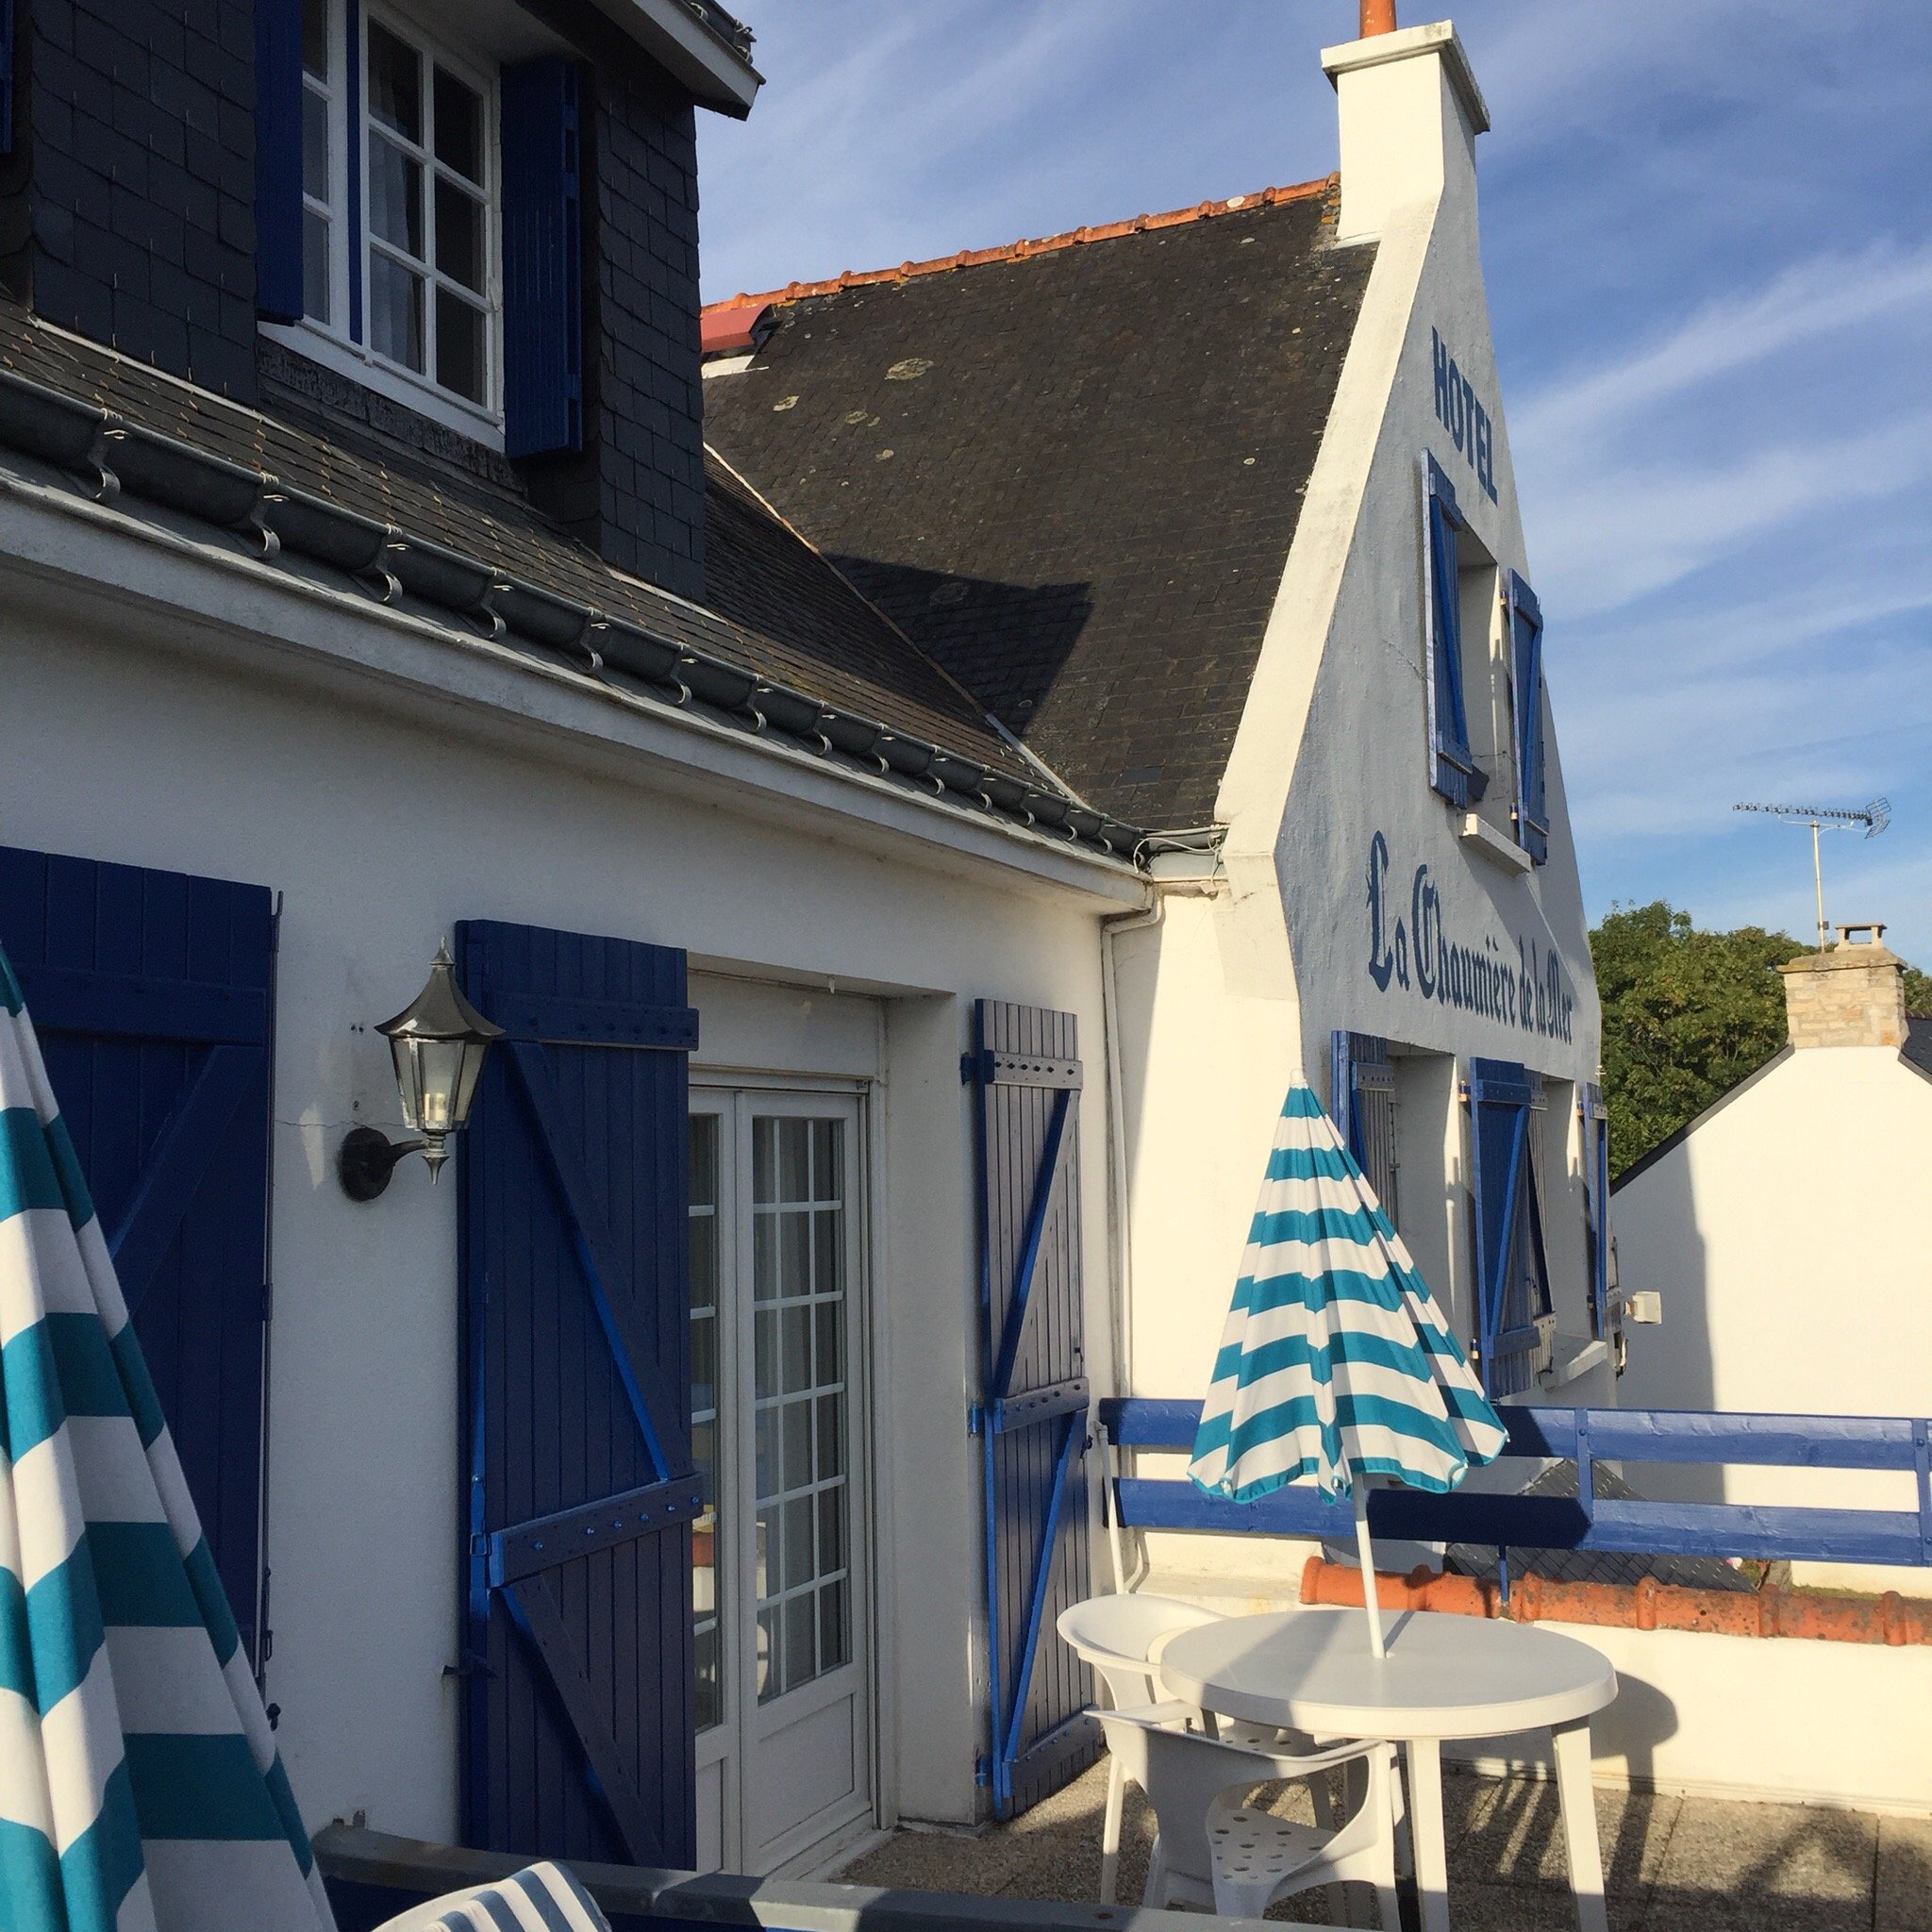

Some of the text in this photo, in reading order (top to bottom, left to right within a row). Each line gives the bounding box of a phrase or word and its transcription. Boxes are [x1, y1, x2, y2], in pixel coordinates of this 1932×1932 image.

[1432, 325, 1497, 507] HOTEL
[1366, 830, 1572, 1045] La Chaumière de la Mer
